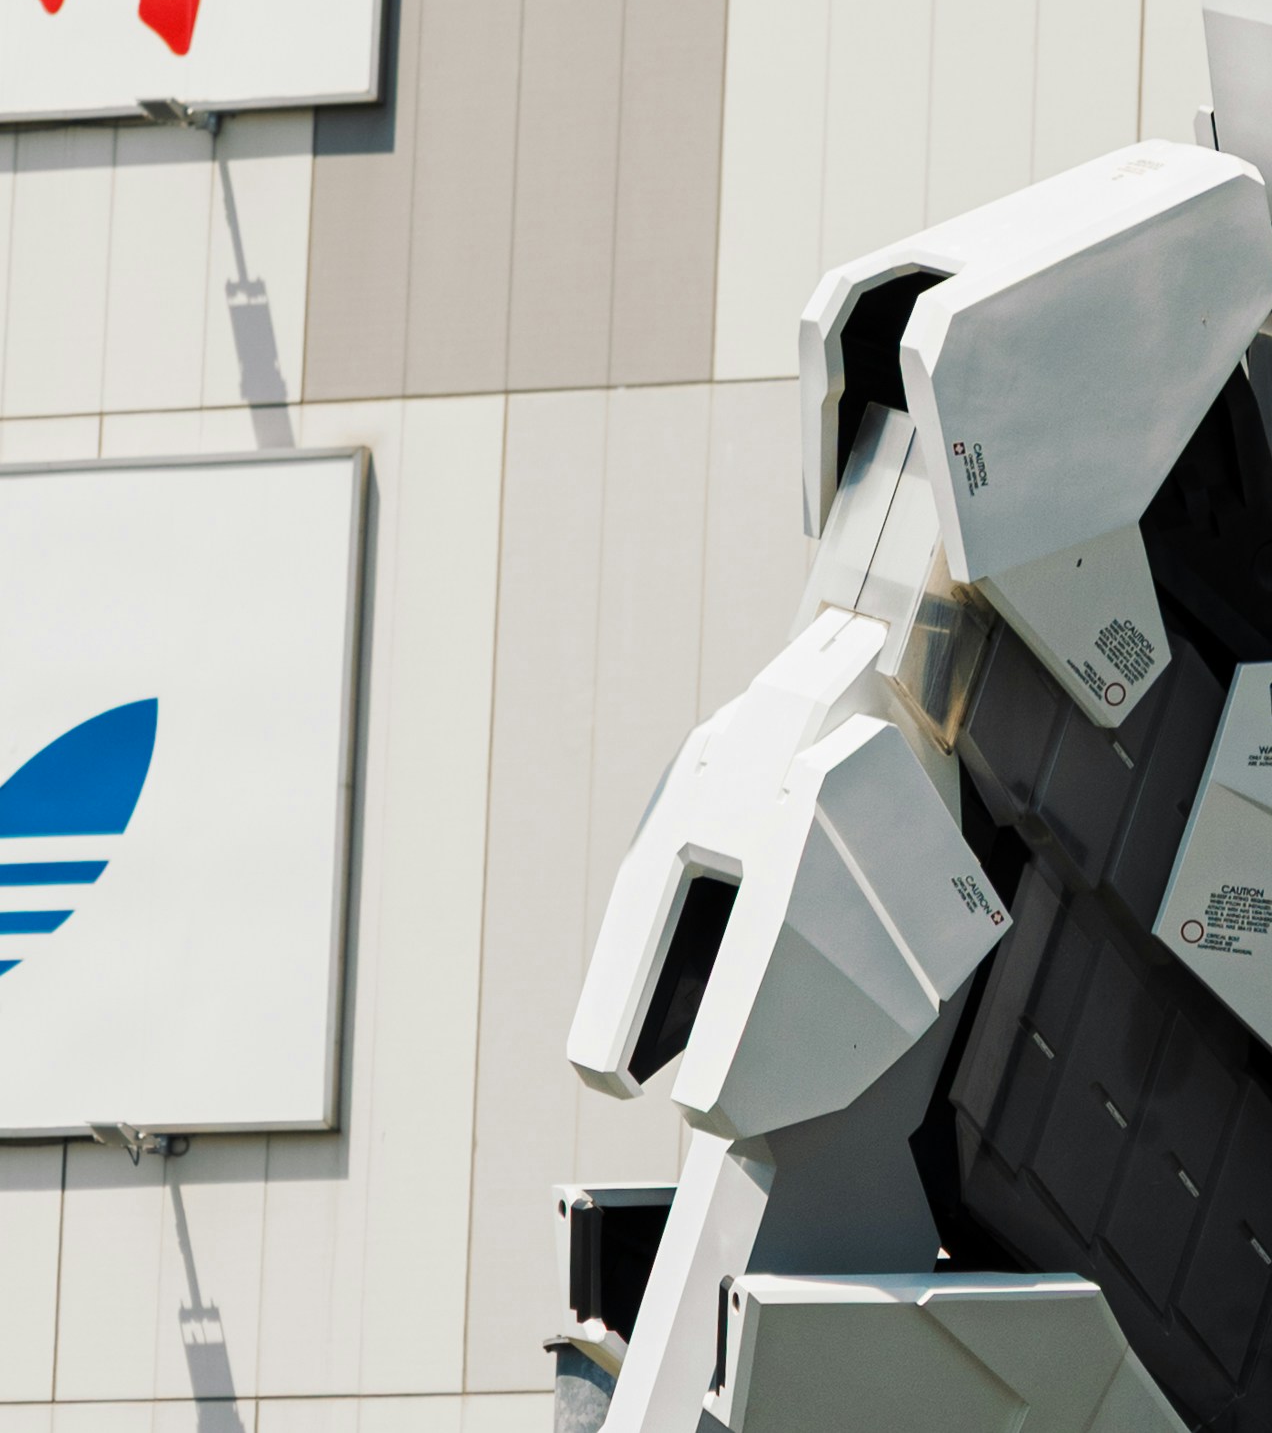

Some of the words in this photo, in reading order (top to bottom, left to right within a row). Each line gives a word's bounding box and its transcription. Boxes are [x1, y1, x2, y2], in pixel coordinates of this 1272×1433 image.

[973, 443, 988, 487] CAUTION
[1120, 620, 1155, 654] CAUTION
[965, 875, 994, 915] CAUTION
[1221, 885, 1264, 898] CAUTION
